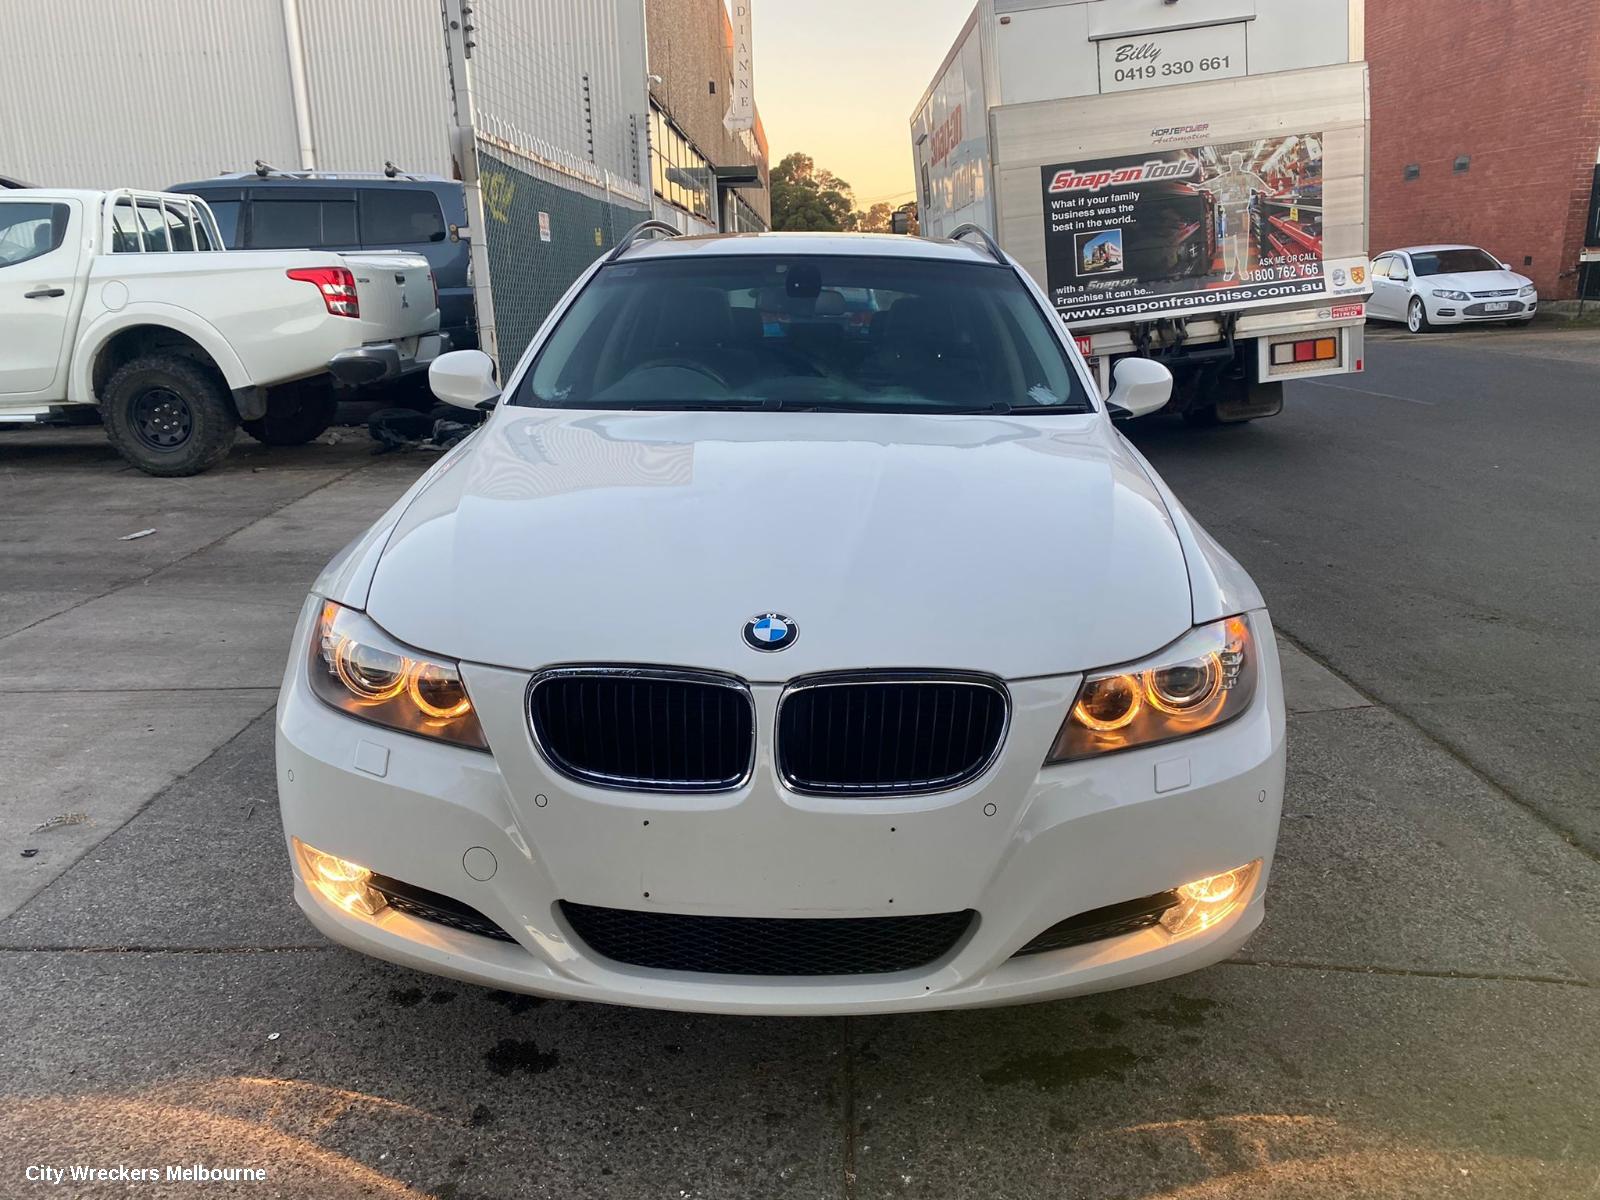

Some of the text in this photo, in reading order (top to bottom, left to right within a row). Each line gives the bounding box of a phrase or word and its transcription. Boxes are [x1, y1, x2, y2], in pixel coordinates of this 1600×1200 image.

[737, 6, 749, 107] DIANNE
[1115, 42, 1161, 63] Billy
[1114, 55, 1230, 82] 0419 330 661
[1050, 159, 1198, 191] Snap-on Tools
[1051, 191, 1140, 209] What if your family
[1052, 204, 1135, 221] business was the
[1052, 222, 1073, 232] best
[1075, 221, 1085, 229] in
[1087, 219, 1102, 228] the
[1259, 252, 1317, 267] ASK ME OR CALL
[1249, 262, 1319, 282] 1800 762 766
[1056, 285, 1076, 294] with
[1057, 287, 1154, 305] Franchise it can be...
[1333, 310, 1357, 318] HINO
[750, 613, 795, 625] BMW
